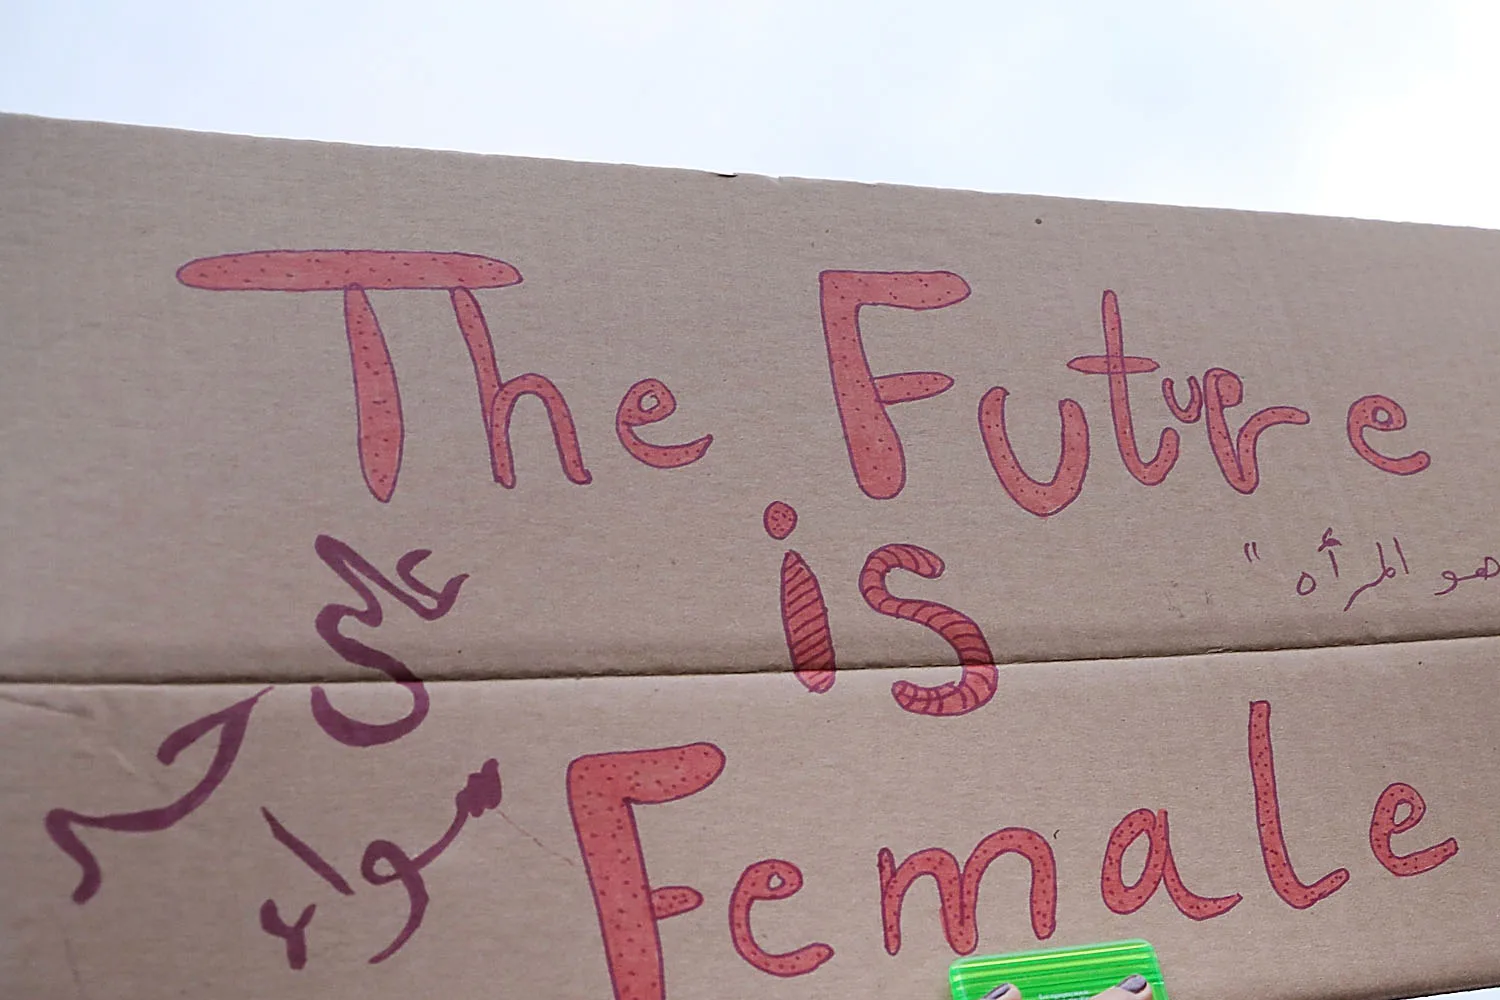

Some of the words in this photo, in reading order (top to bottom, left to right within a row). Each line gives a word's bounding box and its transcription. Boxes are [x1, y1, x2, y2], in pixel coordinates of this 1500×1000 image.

[176, 248, 714, 502] The
[820, 269, 1431, 517] Future
[763, 500, 999, 717] is
